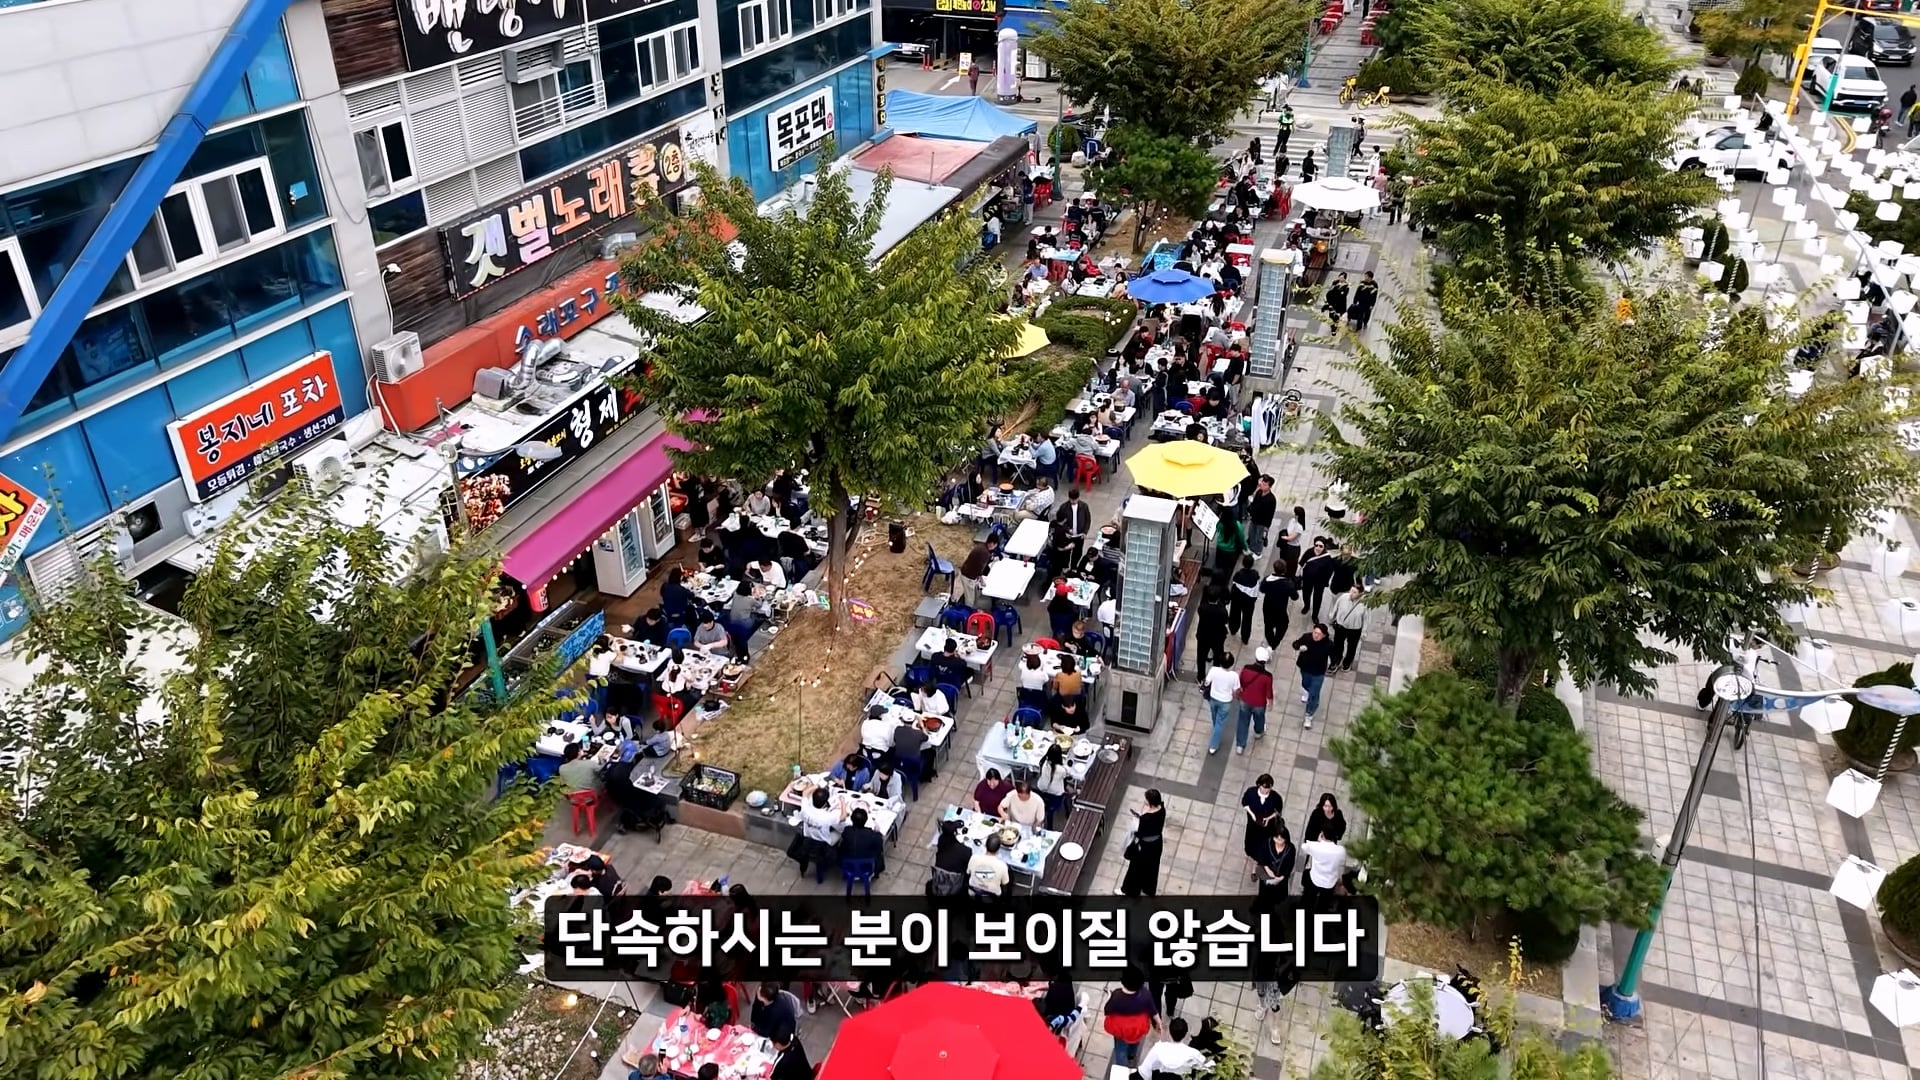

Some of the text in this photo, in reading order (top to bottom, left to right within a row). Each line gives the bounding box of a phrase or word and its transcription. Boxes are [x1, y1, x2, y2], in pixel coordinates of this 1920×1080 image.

[777, 95, 827, 149] 목포댁
[197, 374, 329, 464] 봉지네 포차
[303, 413, 337, 438] 생선구이
[570, 387, 618, 448] 형제
[18, 503, 47, 539] 매운탕
